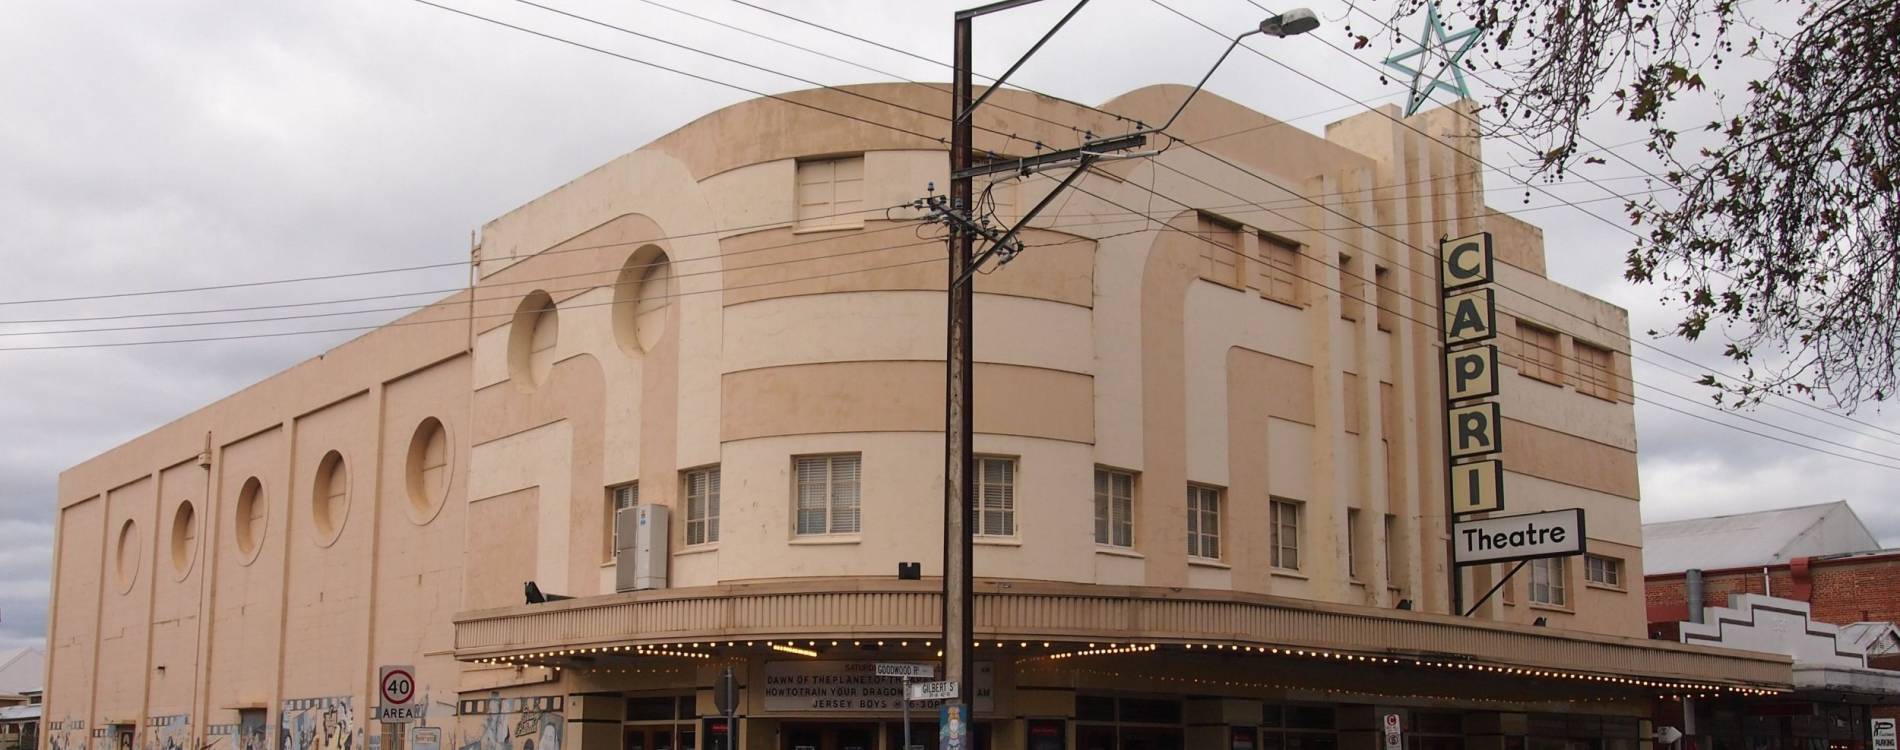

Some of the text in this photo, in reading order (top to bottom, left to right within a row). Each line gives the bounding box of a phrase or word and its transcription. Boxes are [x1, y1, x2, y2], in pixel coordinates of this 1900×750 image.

[1448, 242, 1489, 506] CAPRI
[1462, 523, 1566, 551] Theatre
[878, 664, 912, 675] GOODWOOD
[767, 675, 793, 684] DAWN
[797, 675, 809, 684] OF
[387, 680, 409, 694] 40
[830, 687, 857, 696] YOUR
[863, 687, 903, 696] DRAGON
[922, 682, 947, 694] GILBERT
[812, 699, 851, 708] JERSEY
[860, 699, 888, 708] BOYS
[383, 708, 413, 718] AREA
